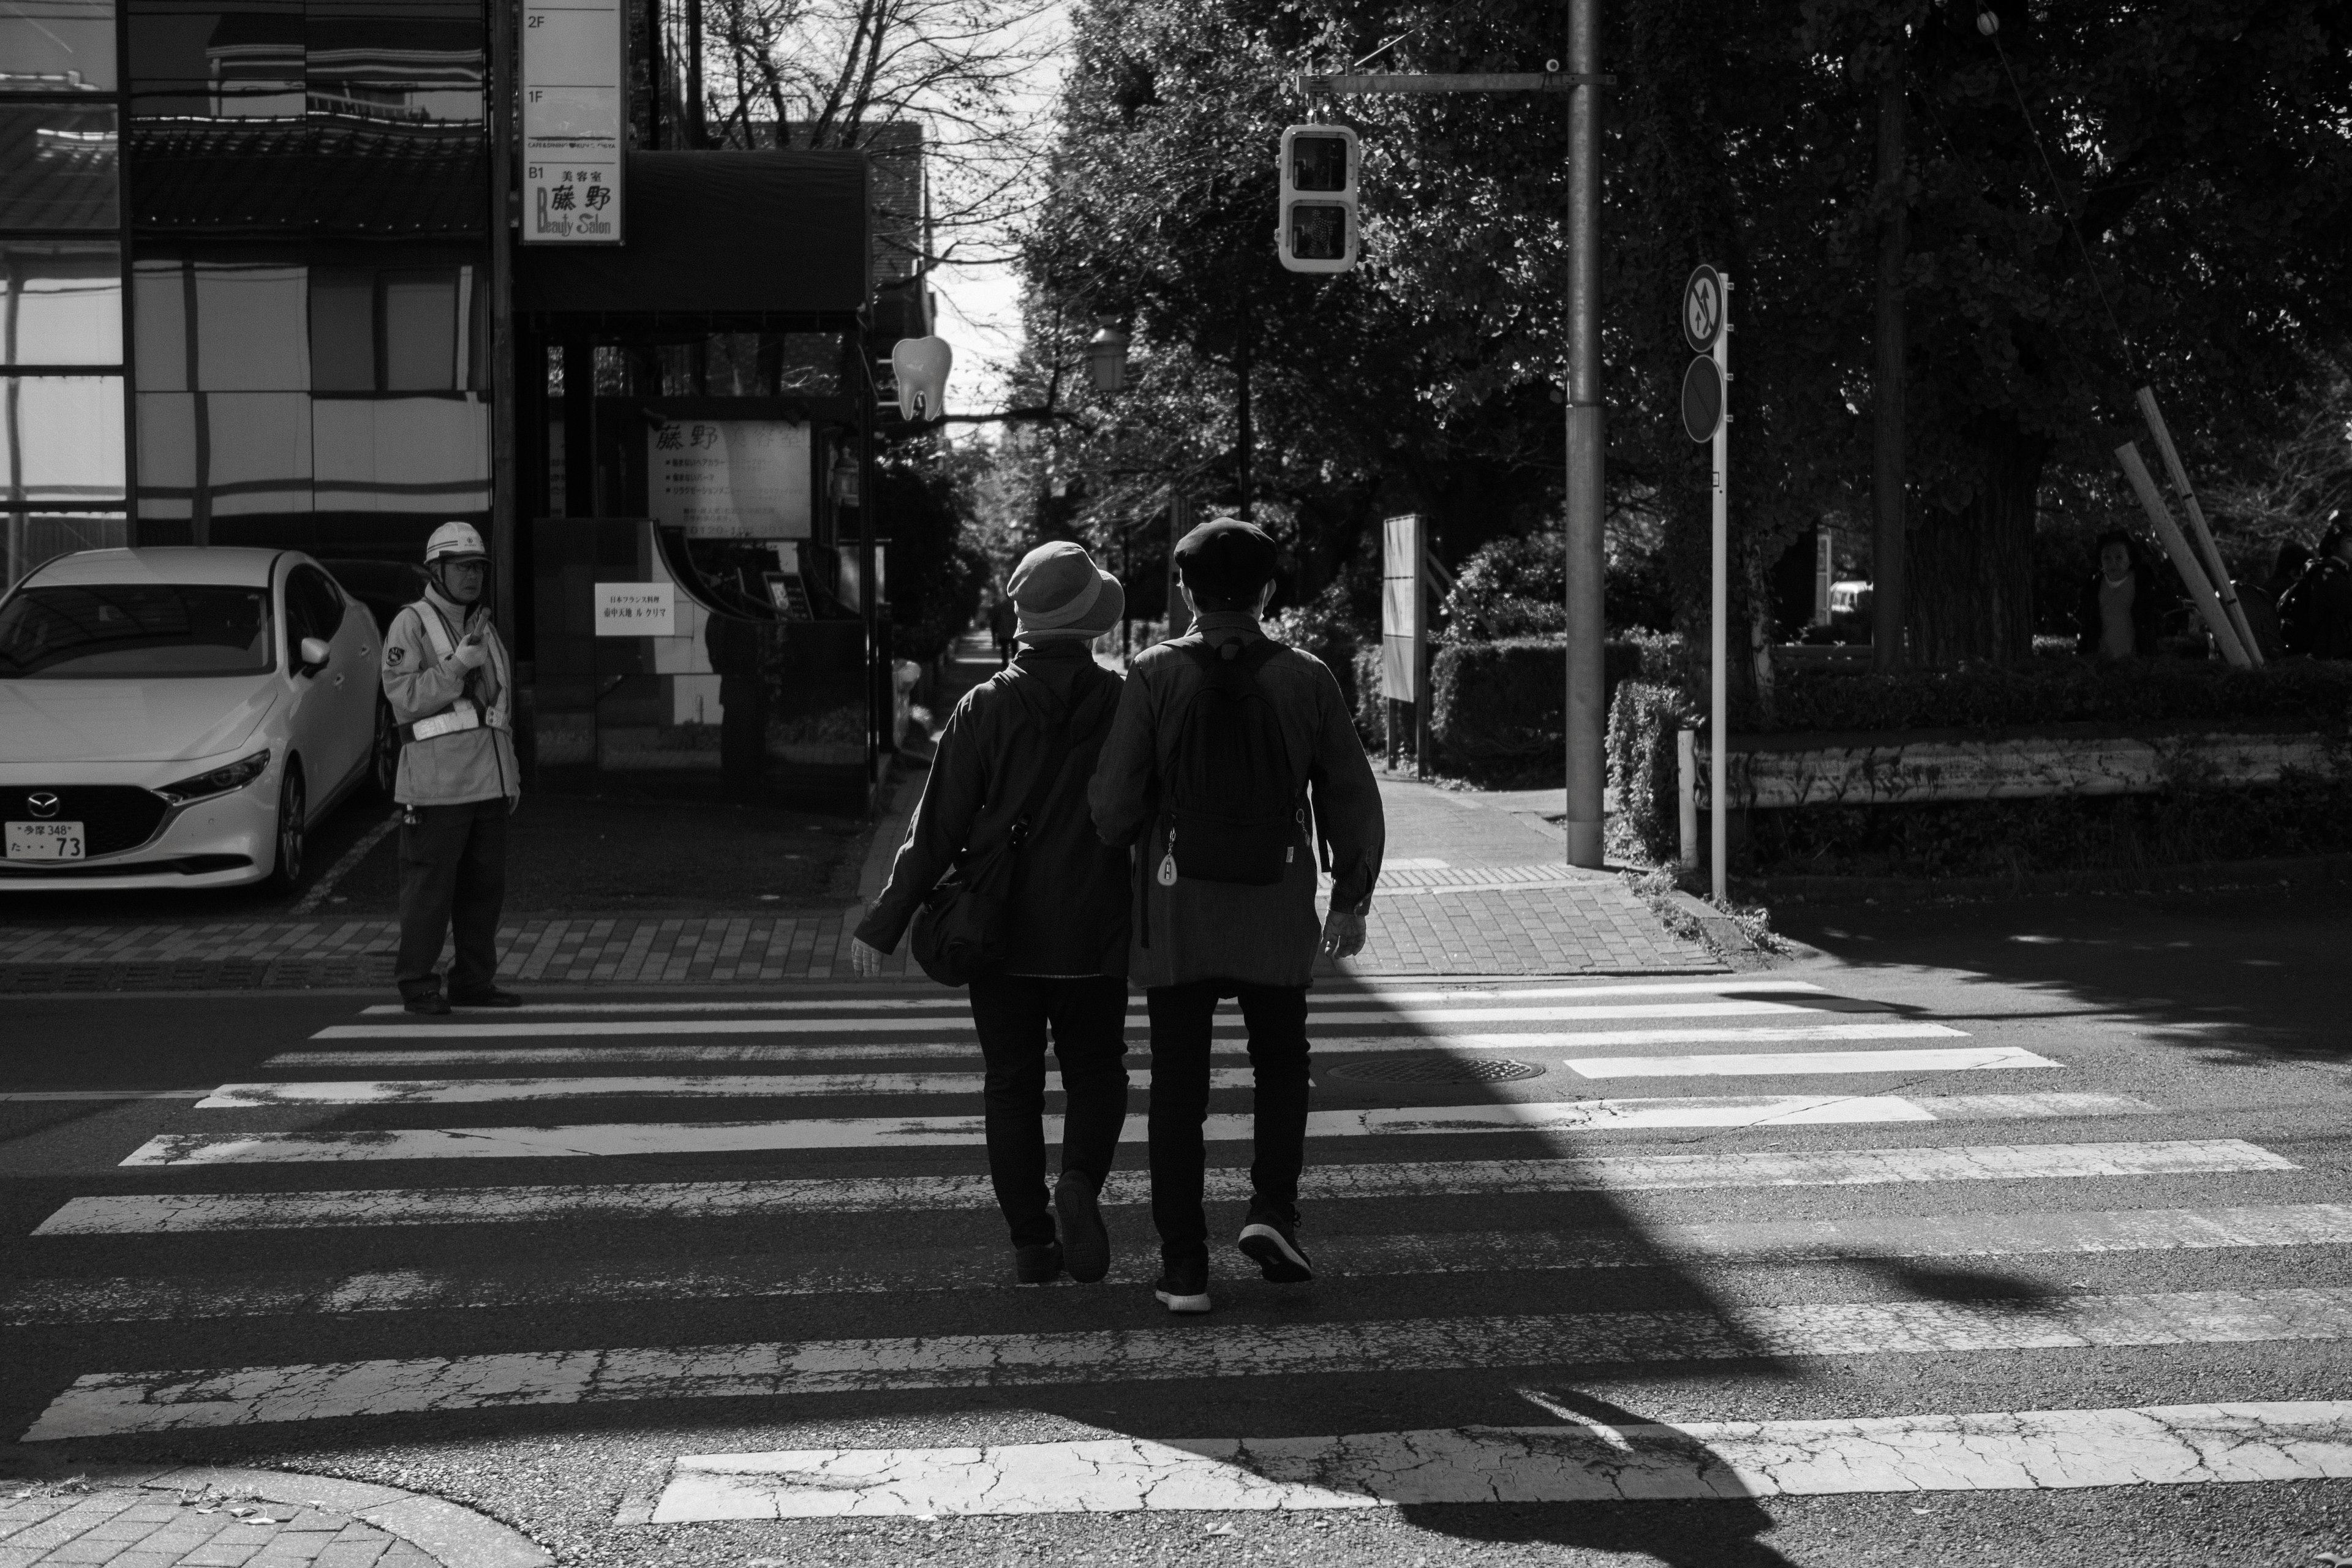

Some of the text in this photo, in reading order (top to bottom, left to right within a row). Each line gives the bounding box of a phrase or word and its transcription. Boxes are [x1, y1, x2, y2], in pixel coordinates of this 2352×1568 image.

[528, 16, 545, 28] 2F
[529, 91, 543, 102] 1F
[529, 167, 543, 178] B1
[562, 171, 601, 182] 美容室
[552, 185, 611, 211] 藤野
[537, 187, 611, 237] Beauty Salon
[646, 608, 666, 618] クリマ
[24, 825, 67, 835] 多摩 348
[11, 843, 21, 851] た
